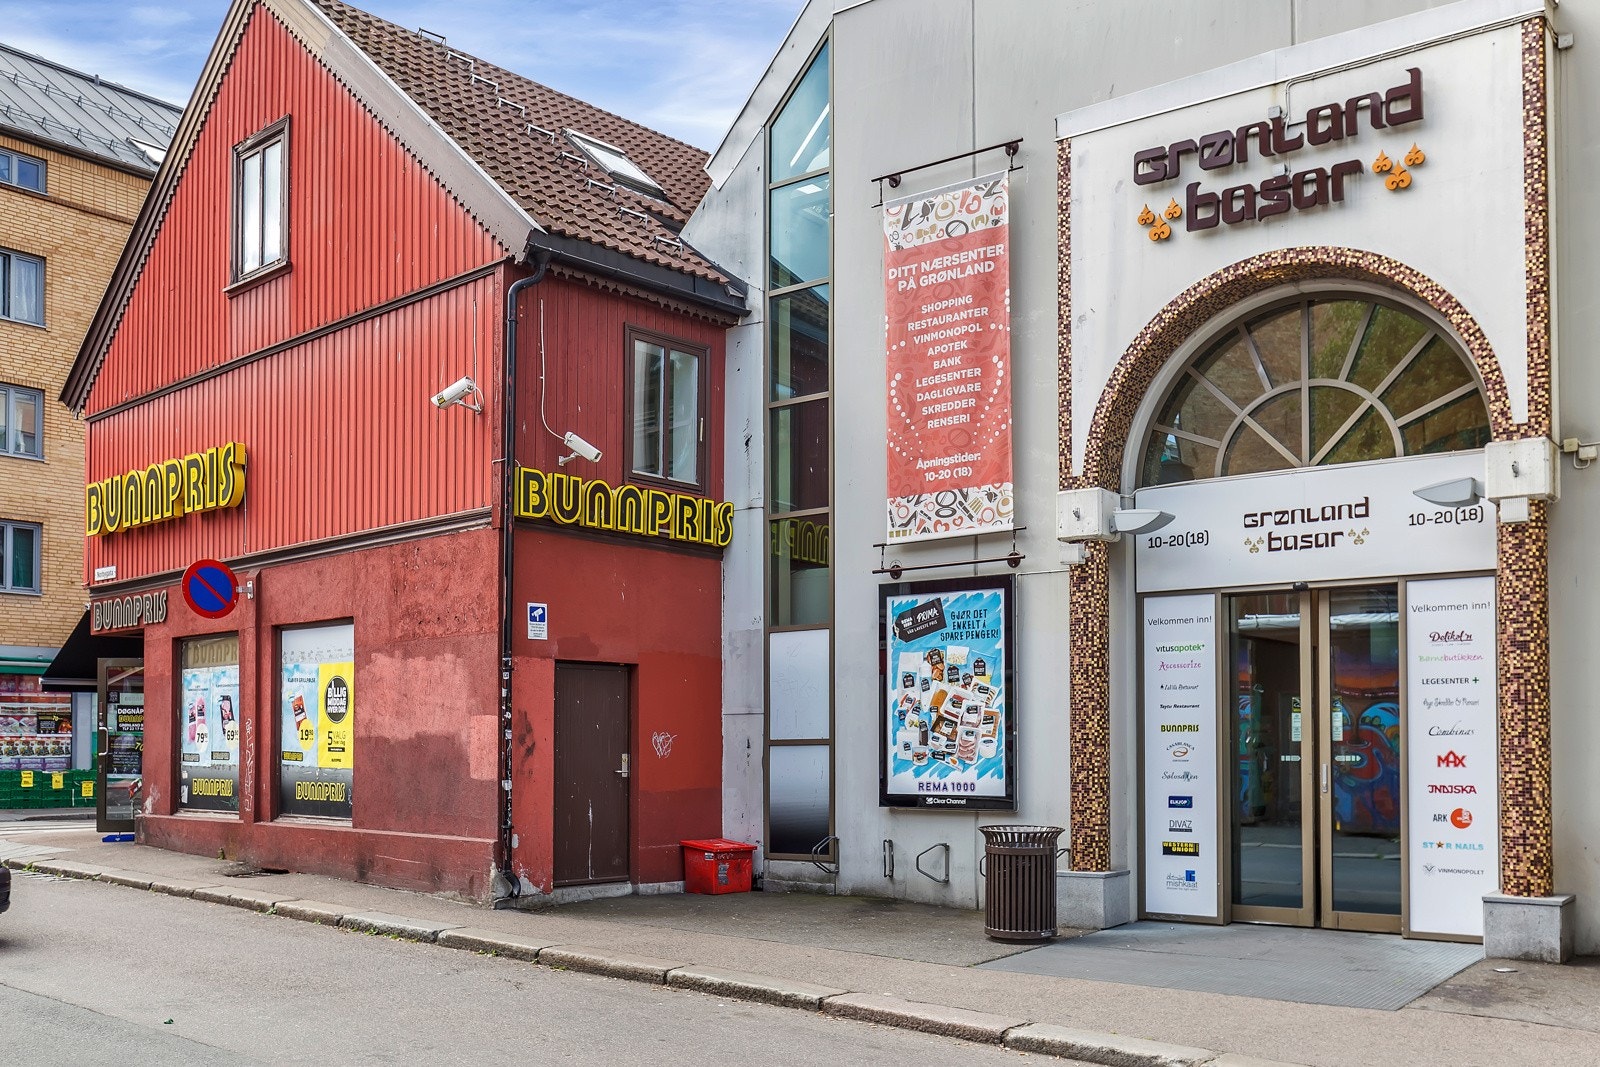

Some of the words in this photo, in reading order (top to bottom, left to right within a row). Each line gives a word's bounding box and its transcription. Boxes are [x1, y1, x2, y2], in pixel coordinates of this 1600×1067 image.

[1133, 67, 1424, 186] Grønland
[1185, 159, 1364, 232] basar
[888, 264, 918, 280] DITT
[921, 244, 1005, 275] NÆRSENTER
[898, 275, 917, 292] PÅ
[920, 261, 995, 287] GRØNLAND
[921, 295, 973, 314] SHOPPING
[907, 306, 989, 331] RESTAURANTER
[913, 323, 983, 345] VINMONOPOL
[927, 340, 968, 356] APOTEK
[933, 356, 962, 370] BANK
[916, 368, 982, 388] LEGESENTER
[916, 382, 982, 402] DAGLIGVARE
[921, 398, 976, 415] SKREDDER
[927, 413, 971, 429] RENSERI
[916, 452, 982, 472] Åpningstider:
[924, 468, 951, 482] 10-20
[952, 466, 973, 480] (18)
[86, 442, 247, 536] BUNNPRIS
[514, 466, 735, 547] BUNNPRIS
[1243, 496, 1370, 528] Grønland
[1268, 530, 1344, 552] basar
[94, 590, 167, 631] BUNNPRIS
[951, 610, 971, 620] GJØR
[973, 609, 987, 619] DET
[1411, 602, 1469, 613] Velkommen
[1471, 601, 1491, 610] inn!
[953, 620, 980, 630] ENKELT
[1148, 616, 1194, 626] Velkommen
[1196, 616, 1212, 624] inn!
[940, 631, 966, 642] SPARE
[966, 629, 999, 640] PENGER!
[1422, 677, 1470, 685] LEGESENTER
[226, 730, 235, 740] 69
[1160, 724, 1199, 732] BUNNPRIS
[197, 732, 205, 743] 79
[1437, 750, 1467, 768] MAX
[918, 782, 948, 792] REMA
[951, 782, 976, 792] 1000
[1432, 813, 1448, 822] ARK
[1455, 843, 1484, 851] NAILS
